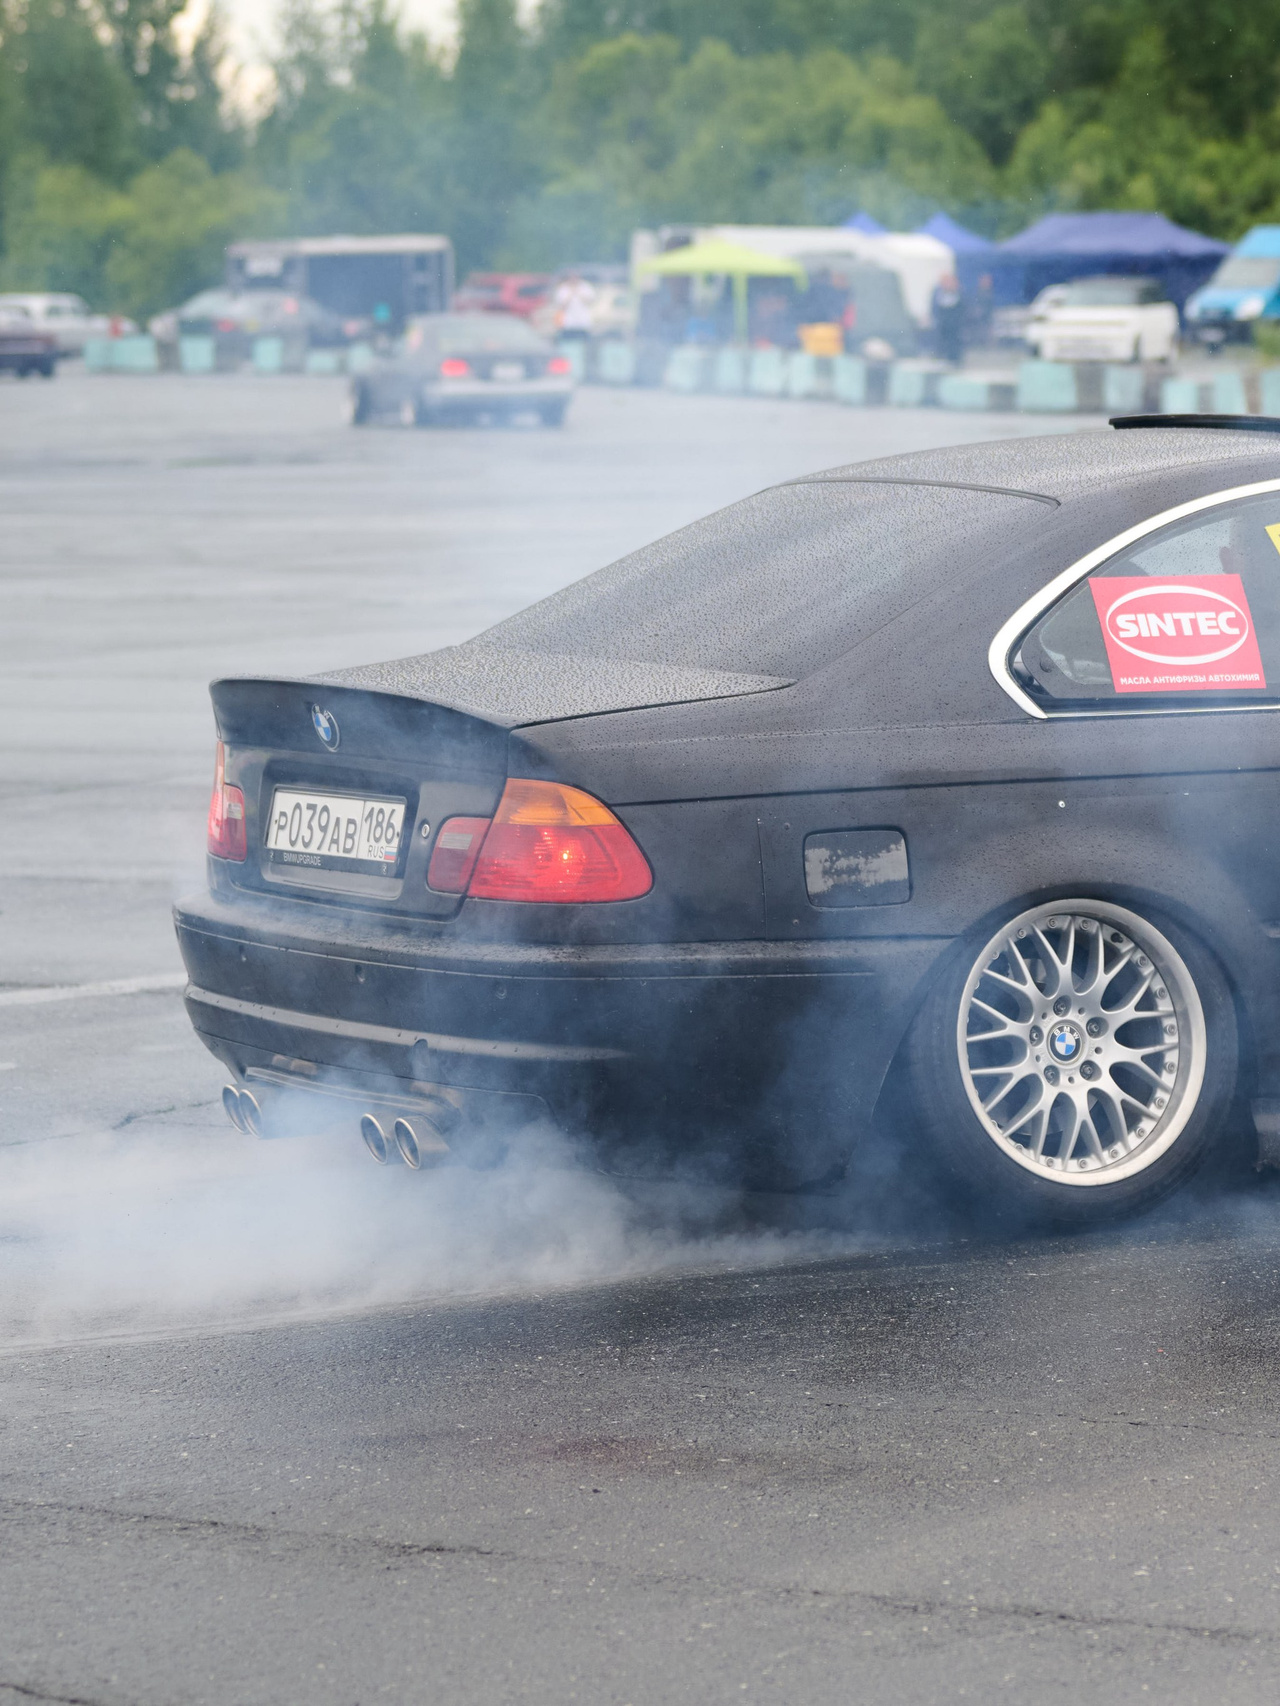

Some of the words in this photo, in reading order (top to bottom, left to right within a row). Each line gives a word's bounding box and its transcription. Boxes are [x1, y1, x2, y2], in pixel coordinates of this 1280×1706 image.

[1115, 611, 1240, 638] SINTEC
[1120, 676, 1151, 685] МАСЛА
[1153, 675, 1206, 684] АНТИФРИЗЫ
[1208, 673, 1260, 682] АВТОХИМИЯ
[364, 807, 396, 844] 186
[367, 845, 384, 859] RUS
[1053, 1025, 1080, 1039] BMW
